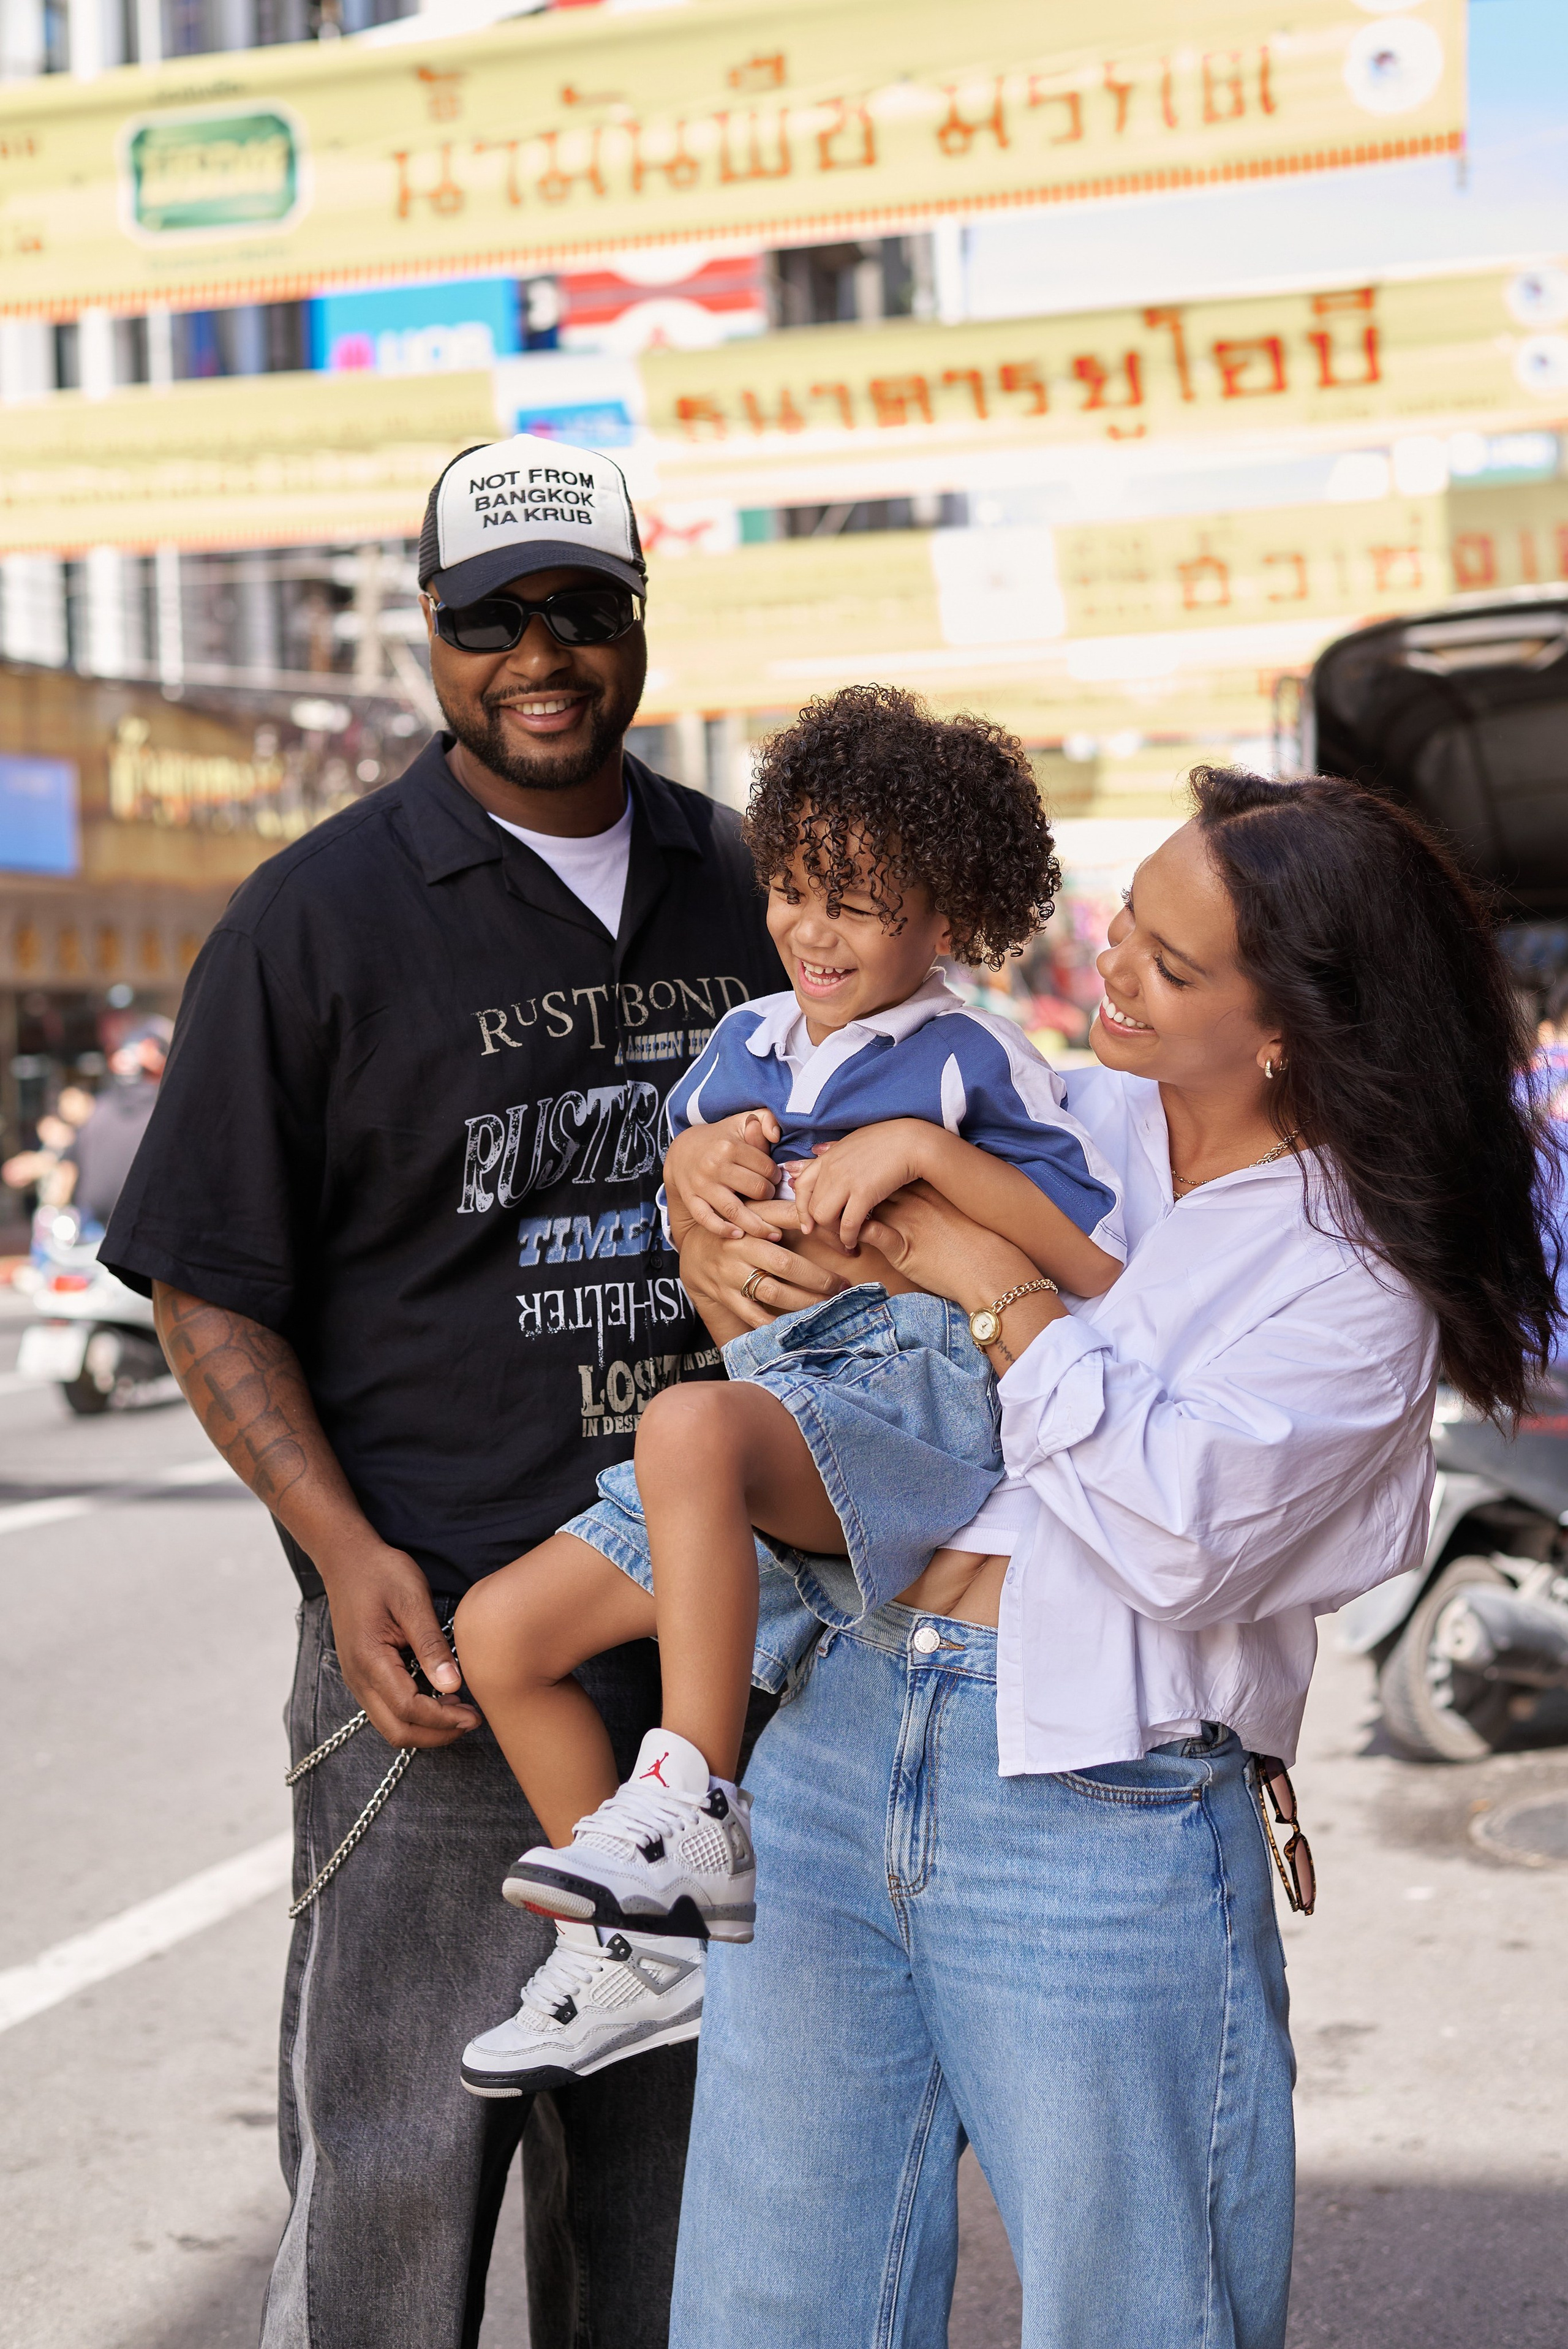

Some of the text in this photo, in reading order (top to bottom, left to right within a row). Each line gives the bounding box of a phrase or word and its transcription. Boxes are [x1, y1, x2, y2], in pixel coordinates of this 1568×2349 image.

[469, 469, 594, 494] NOT FROM
[475, 489, 595, 511] BANGKOK
[483, 508, 592, 529] NA KRUB
[695, 1348, 724, 1368] DES
[582, 1418, 598, 1438] IN
